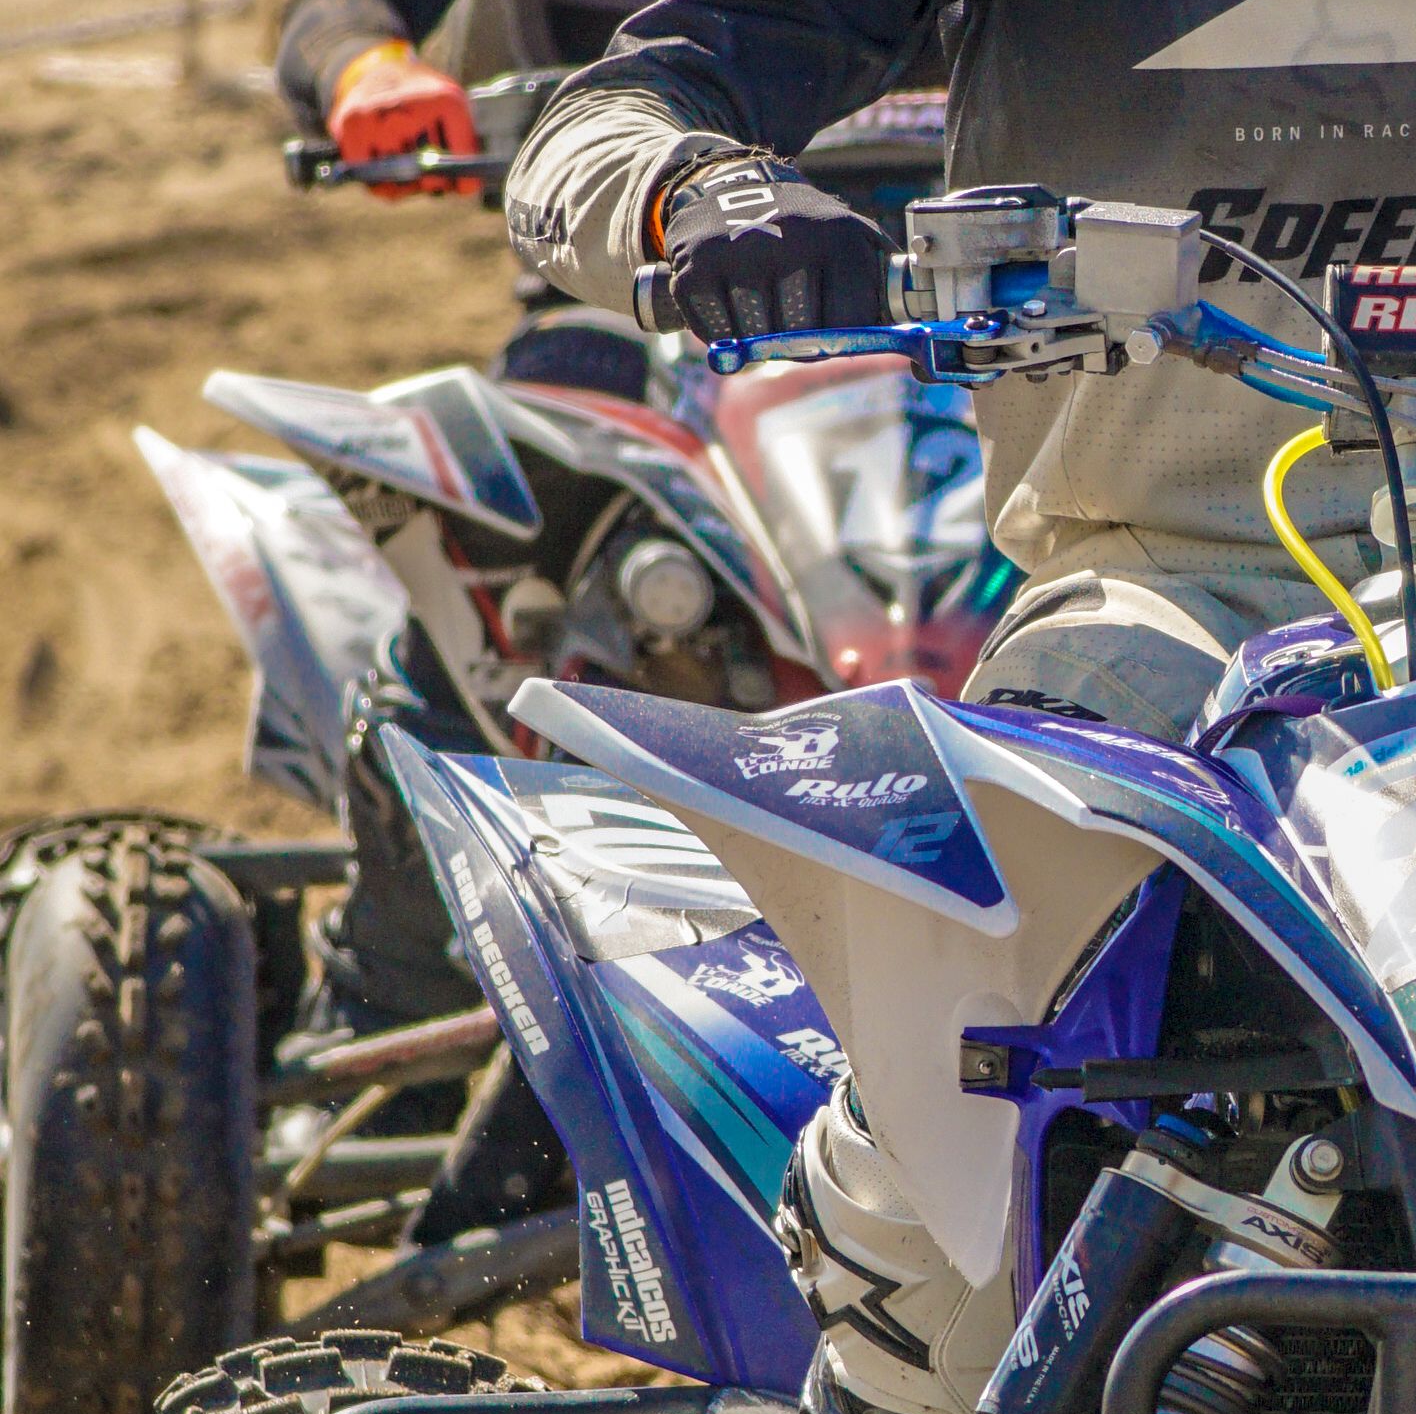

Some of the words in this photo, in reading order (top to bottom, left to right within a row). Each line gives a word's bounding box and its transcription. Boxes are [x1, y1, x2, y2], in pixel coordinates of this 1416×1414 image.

[1235, 126, 1301, 143] BORN
[1319, 125, 1344, 140] IN
[702, 169, 783, 241] FOX
[742, 754, 836, 780] CONDE
[784, 771, 928, 799] Rulo
[868, 810, 962, 864] 12
[472, 922, 552, 1057] BECKER
[1240, 1215, 1324, 1265] AXIS
[586, 1190, 632, 1299] GRAPHIC
[616, 1299, 651, 1343] KIT
